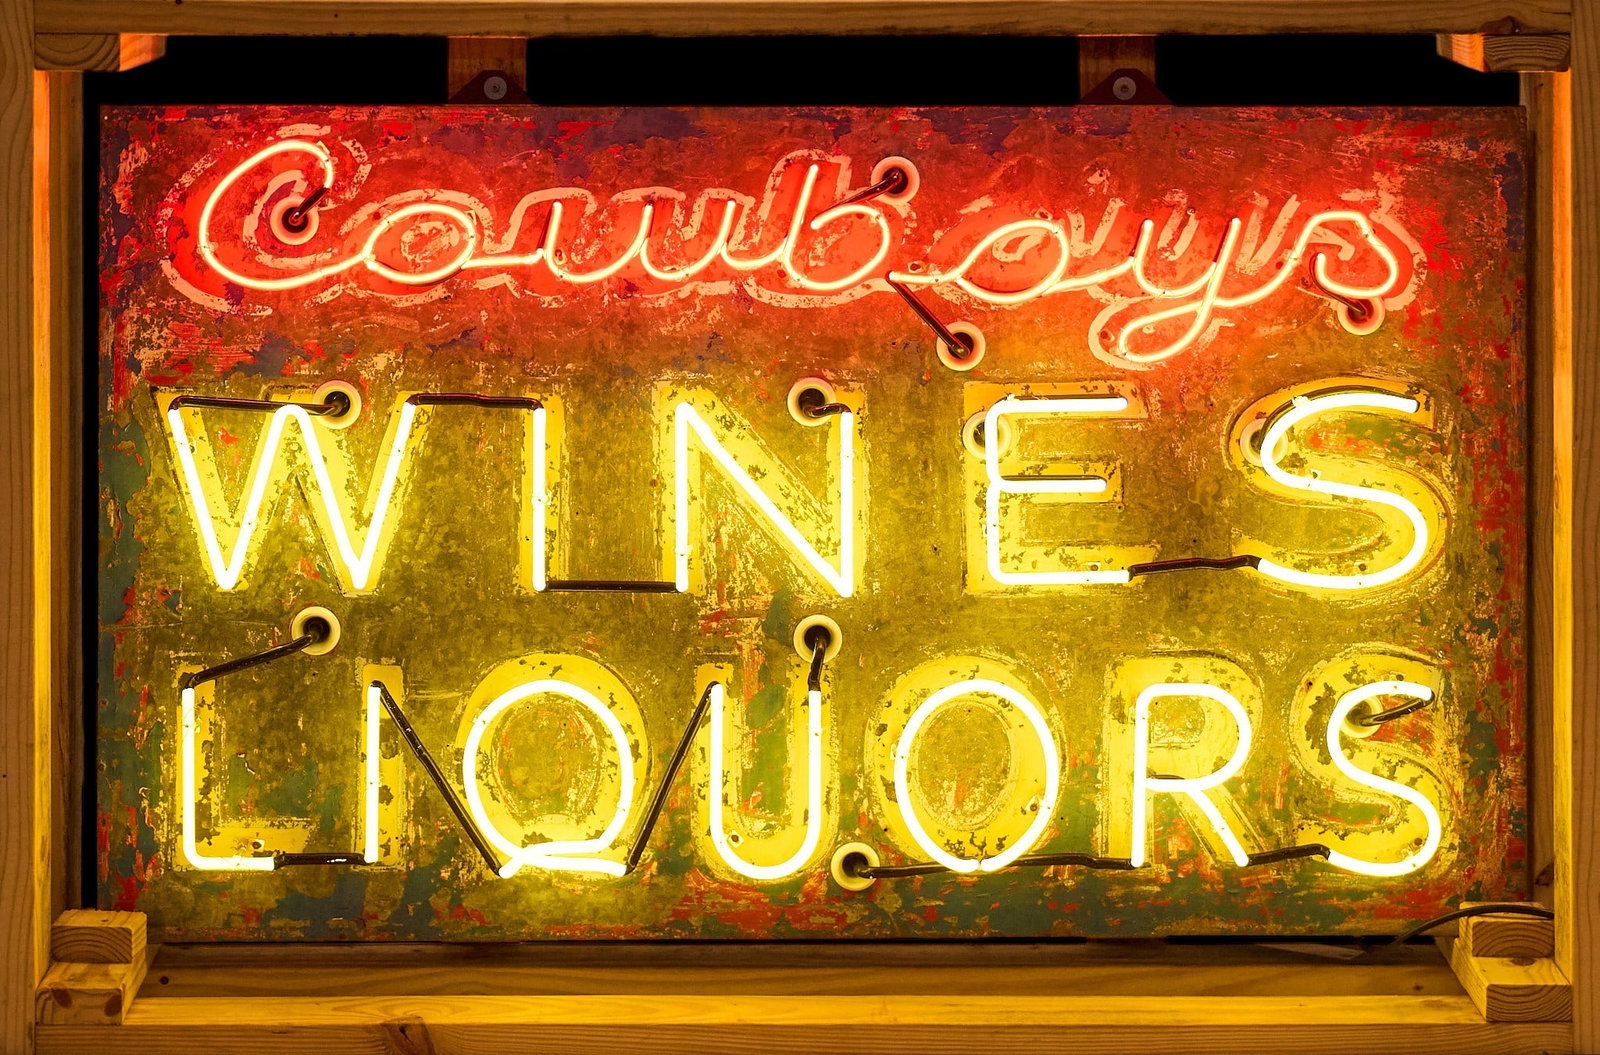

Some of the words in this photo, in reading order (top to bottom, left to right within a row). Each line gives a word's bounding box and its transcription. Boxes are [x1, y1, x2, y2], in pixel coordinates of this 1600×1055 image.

[194, 137, 1401, 364] Cowboys
[165, 391, 1432, 598] WINES
[180, 677, 1444, 881] LIQUORS
